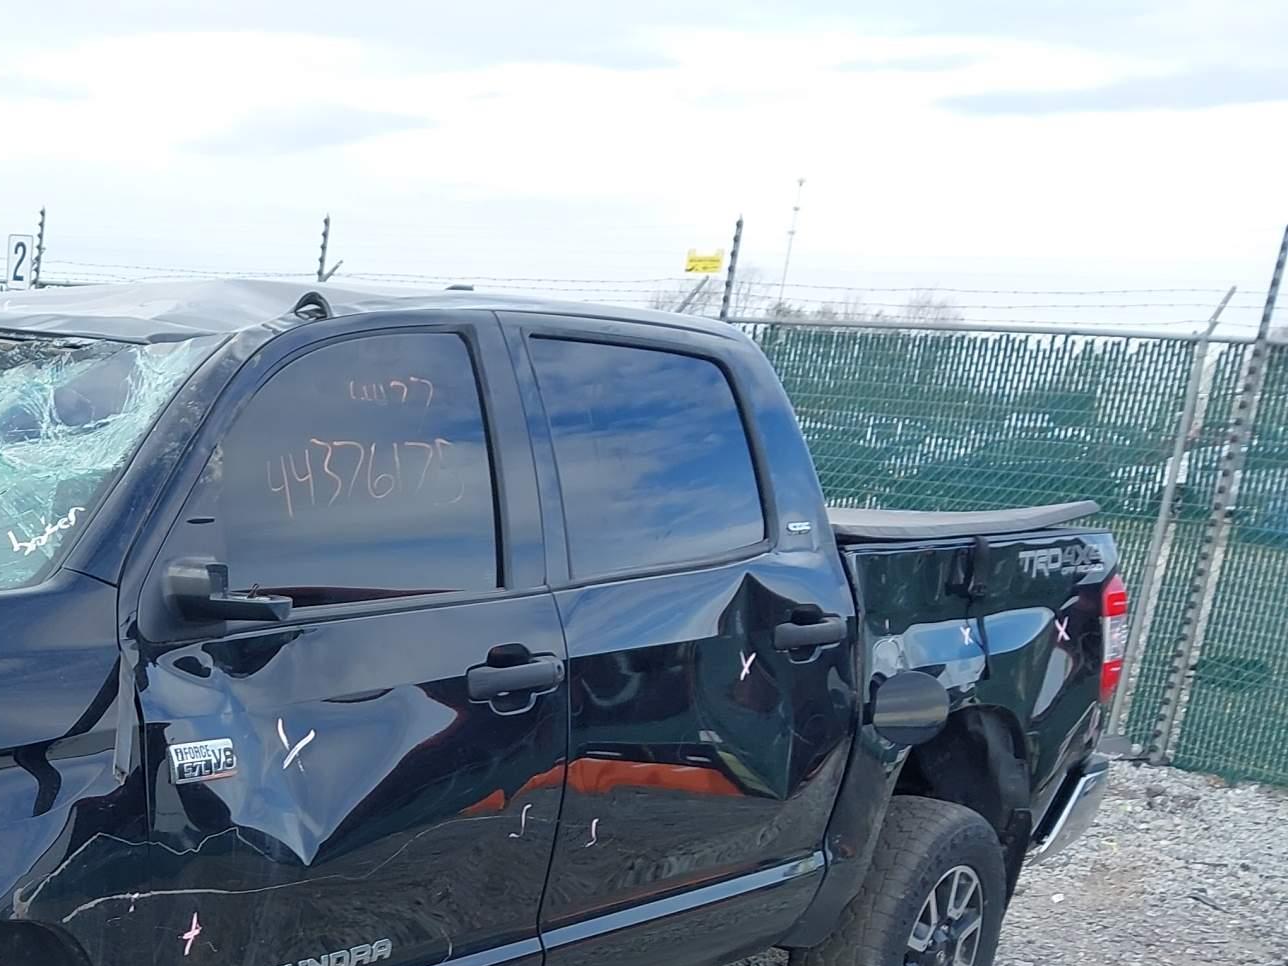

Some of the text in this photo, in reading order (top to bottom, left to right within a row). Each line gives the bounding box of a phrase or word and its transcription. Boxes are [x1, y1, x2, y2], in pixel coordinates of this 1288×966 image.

[13, 241, 26, 281] 2
[1018, 547, 1062, 578] TRD
[212, 748, 236, 771] V8
